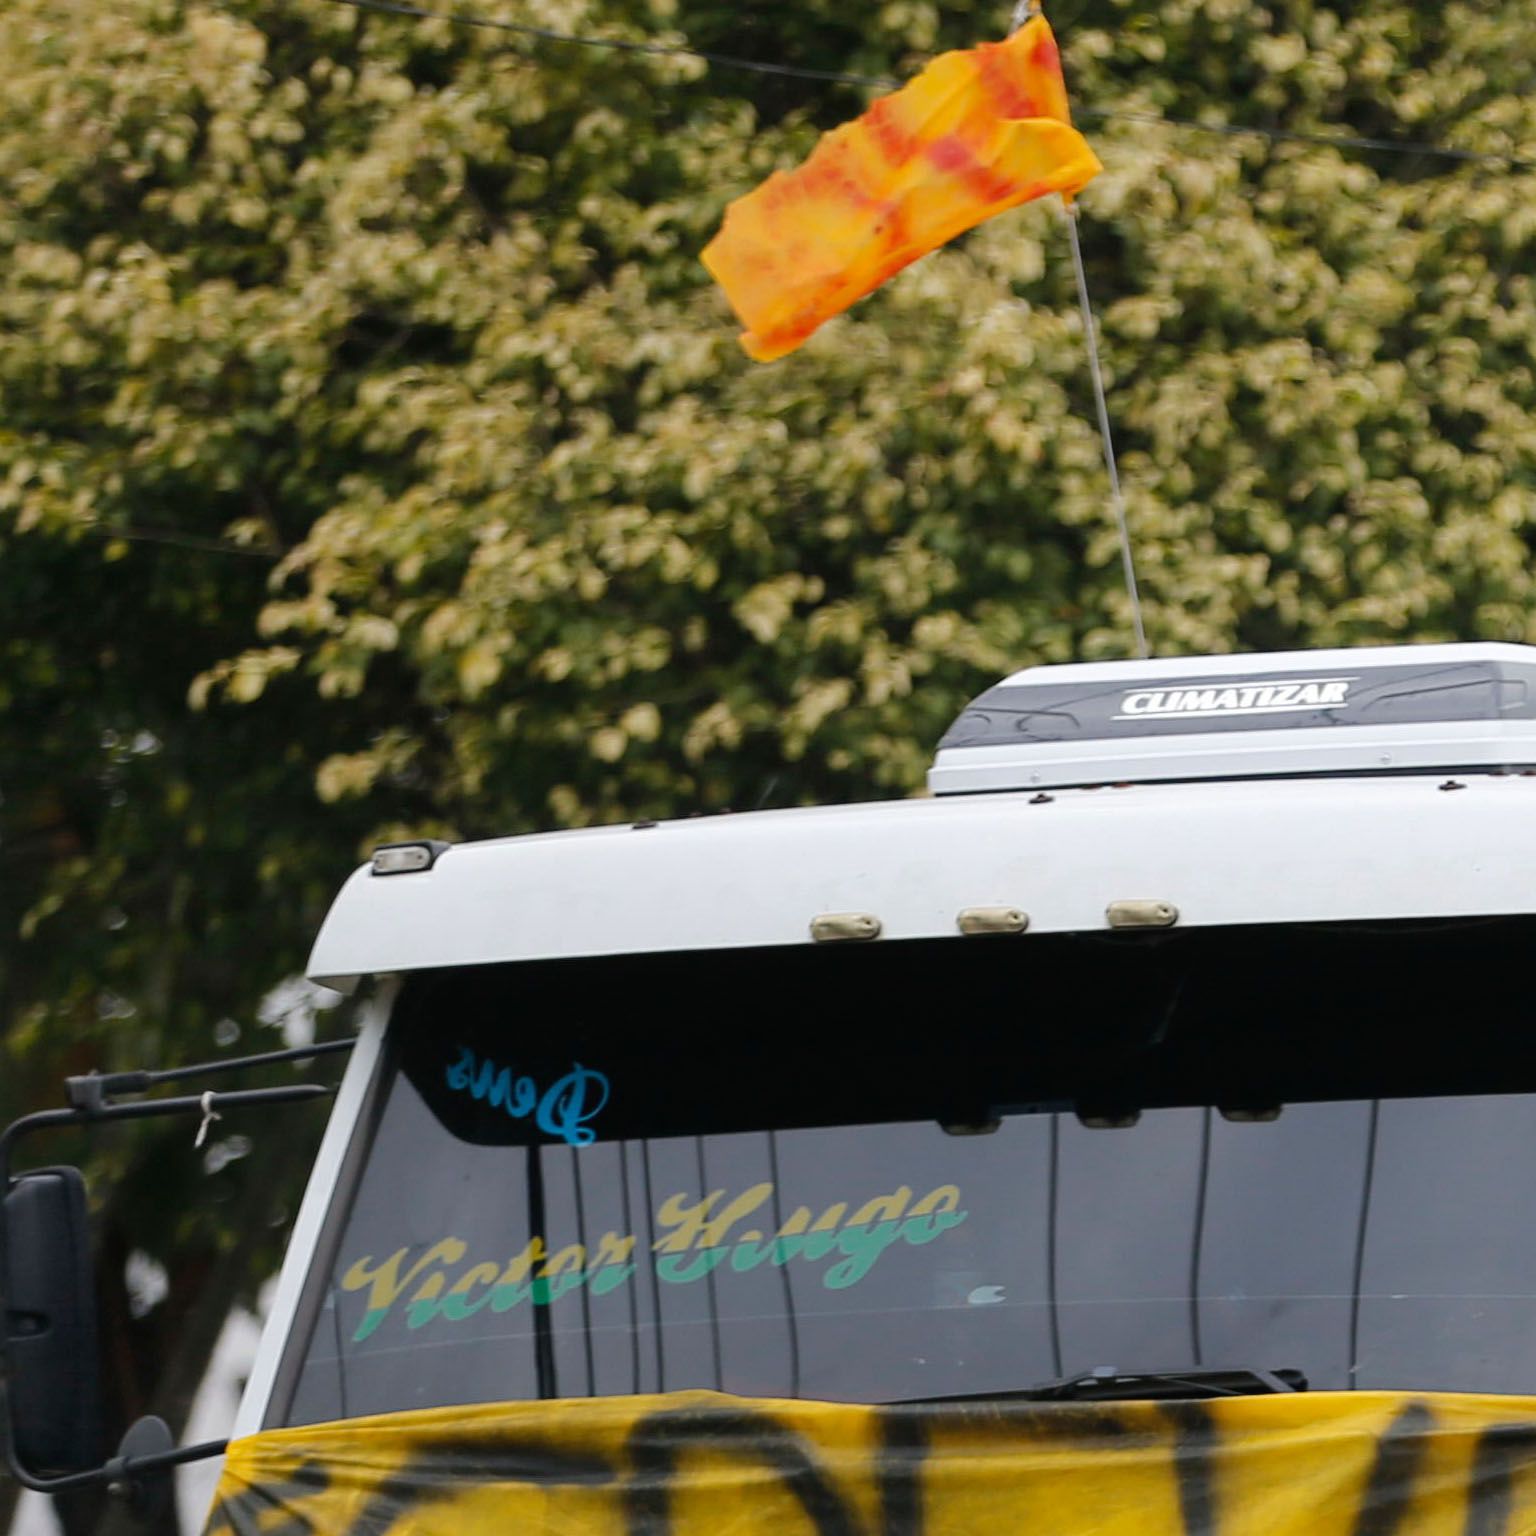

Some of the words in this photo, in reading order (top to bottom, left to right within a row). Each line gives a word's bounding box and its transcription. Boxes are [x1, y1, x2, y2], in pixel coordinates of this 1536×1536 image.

[1121, 683, 1348, 714] CLIMATIZAR
[341, 1231, 637, 1343] Victor
[651, 1181, 968, 1291] Hugo
